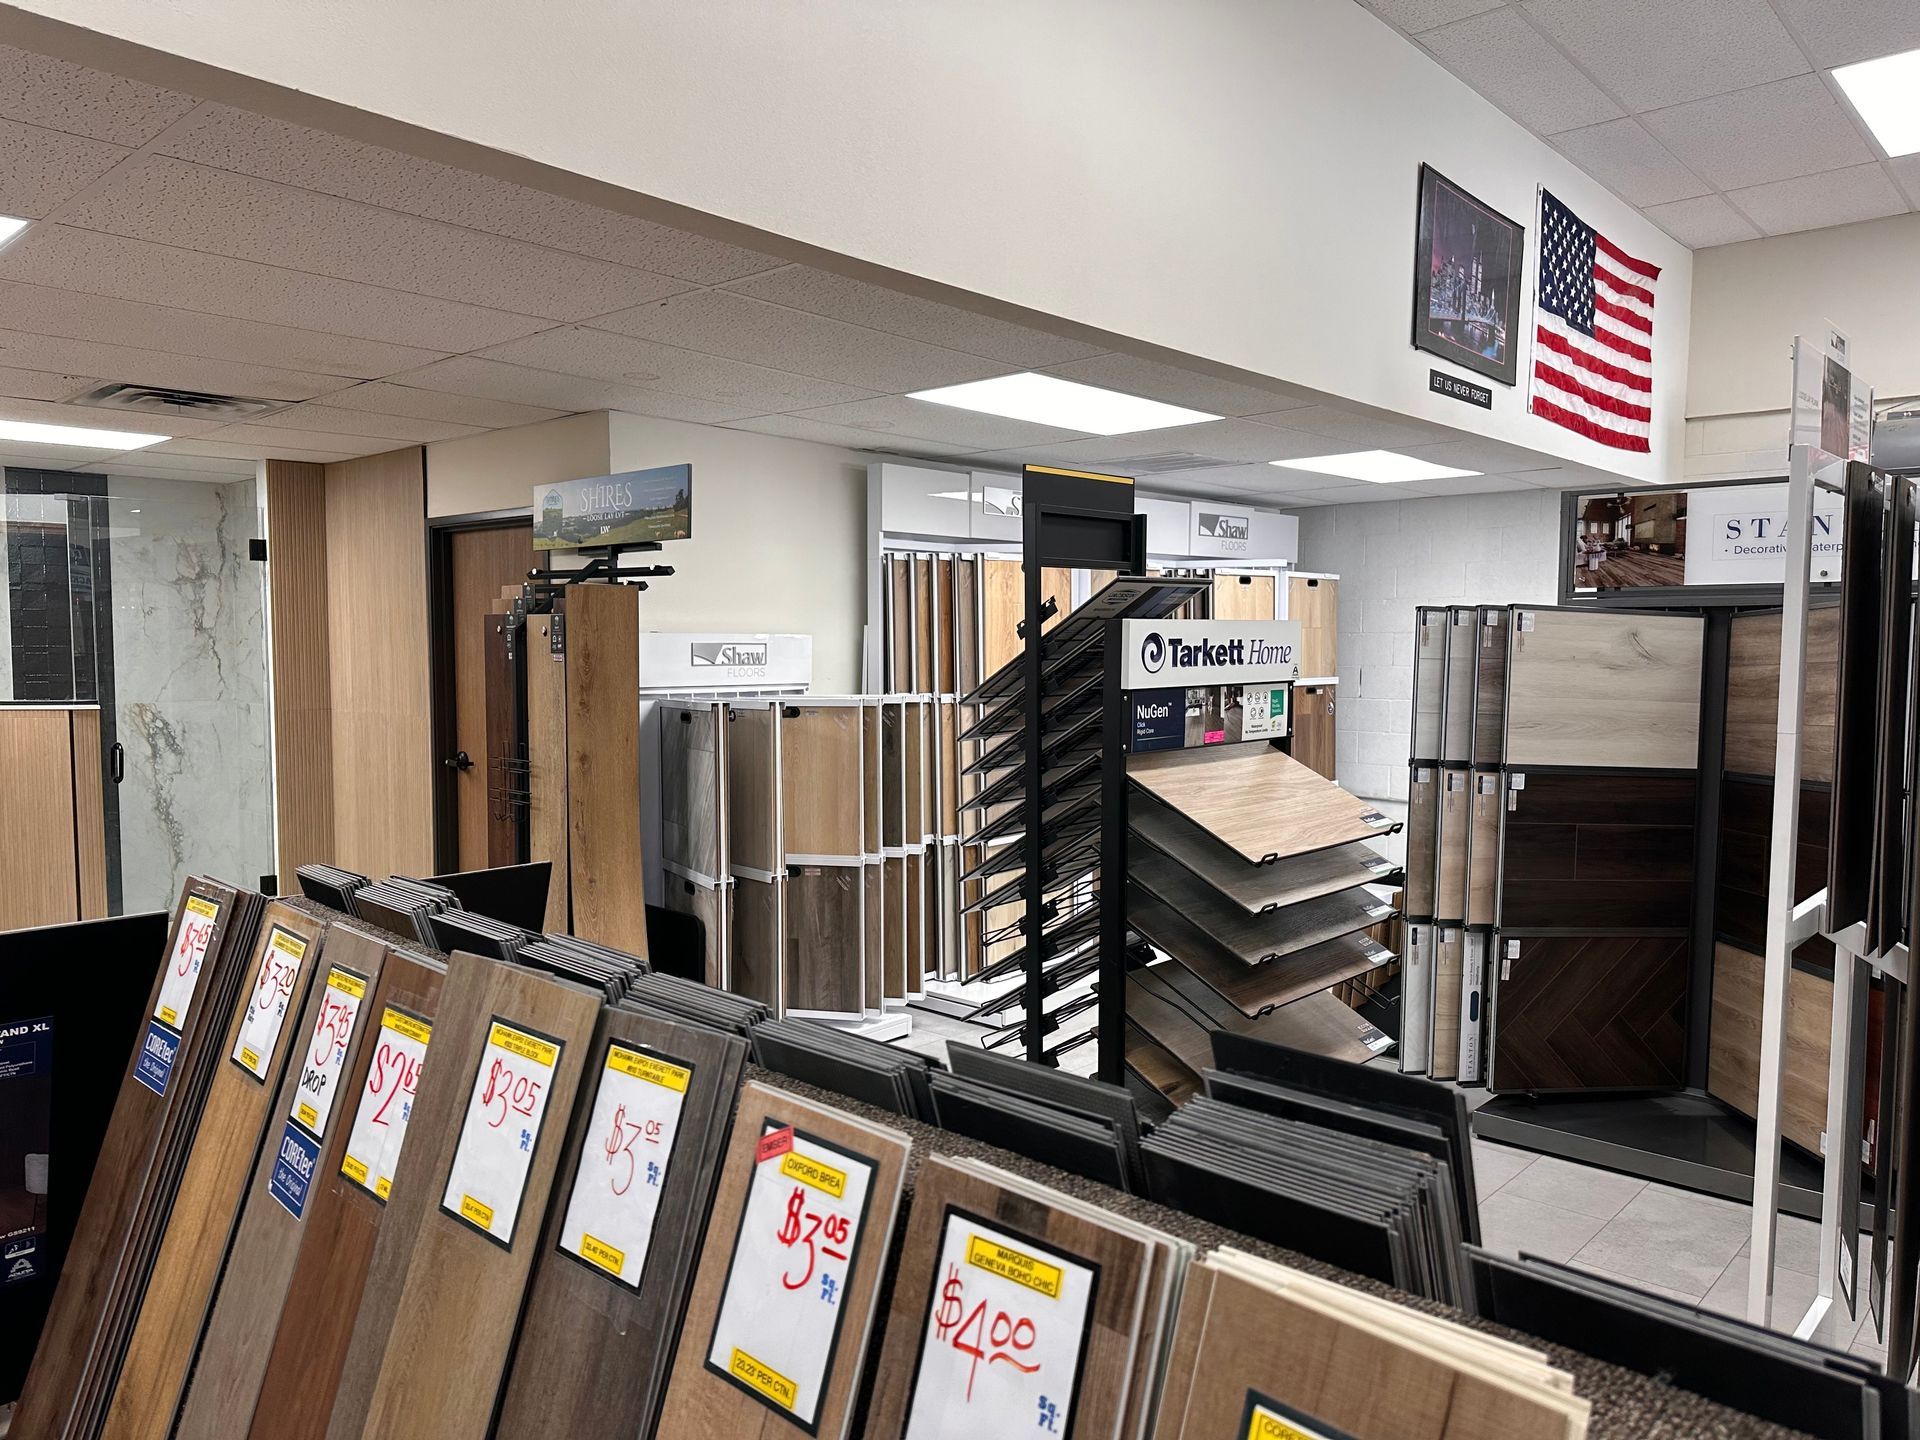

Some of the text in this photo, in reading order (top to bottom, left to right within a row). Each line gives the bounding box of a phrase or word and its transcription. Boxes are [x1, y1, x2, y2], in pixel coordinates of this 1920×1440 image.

[1433, 376, 1488, 403] LET US NEVER FORGET
[580, 482, 632, 512] SHIRES
[1219, 519, 1247, 539] Shaw
[1221, 540, 1247, 551] FLOORS
[721, 646, 765, 665] Shaw
[1168, 638, 1292, 667] Tarkett Home
[727, 667, 765, 677] FLOORS
[1136, 704, 1168, 719] NuGen
[32, 1023, 50, 1032] XL
[301, 1066, 326, 1096] DROP
[671, 1070, 685, 1079] PARK
[762, 1136, 788, 1153] EMSER
[280, 1136, 313, 1179] COREtec
[787, 1158, 841, 1189] OXFORD BREA
[997, 1249, 1034, 1271] MARQUIS
[974, 1253, 1054, 1292] GENEVA BOHO CHIC
[757, 1370, 773, 1388] PER
